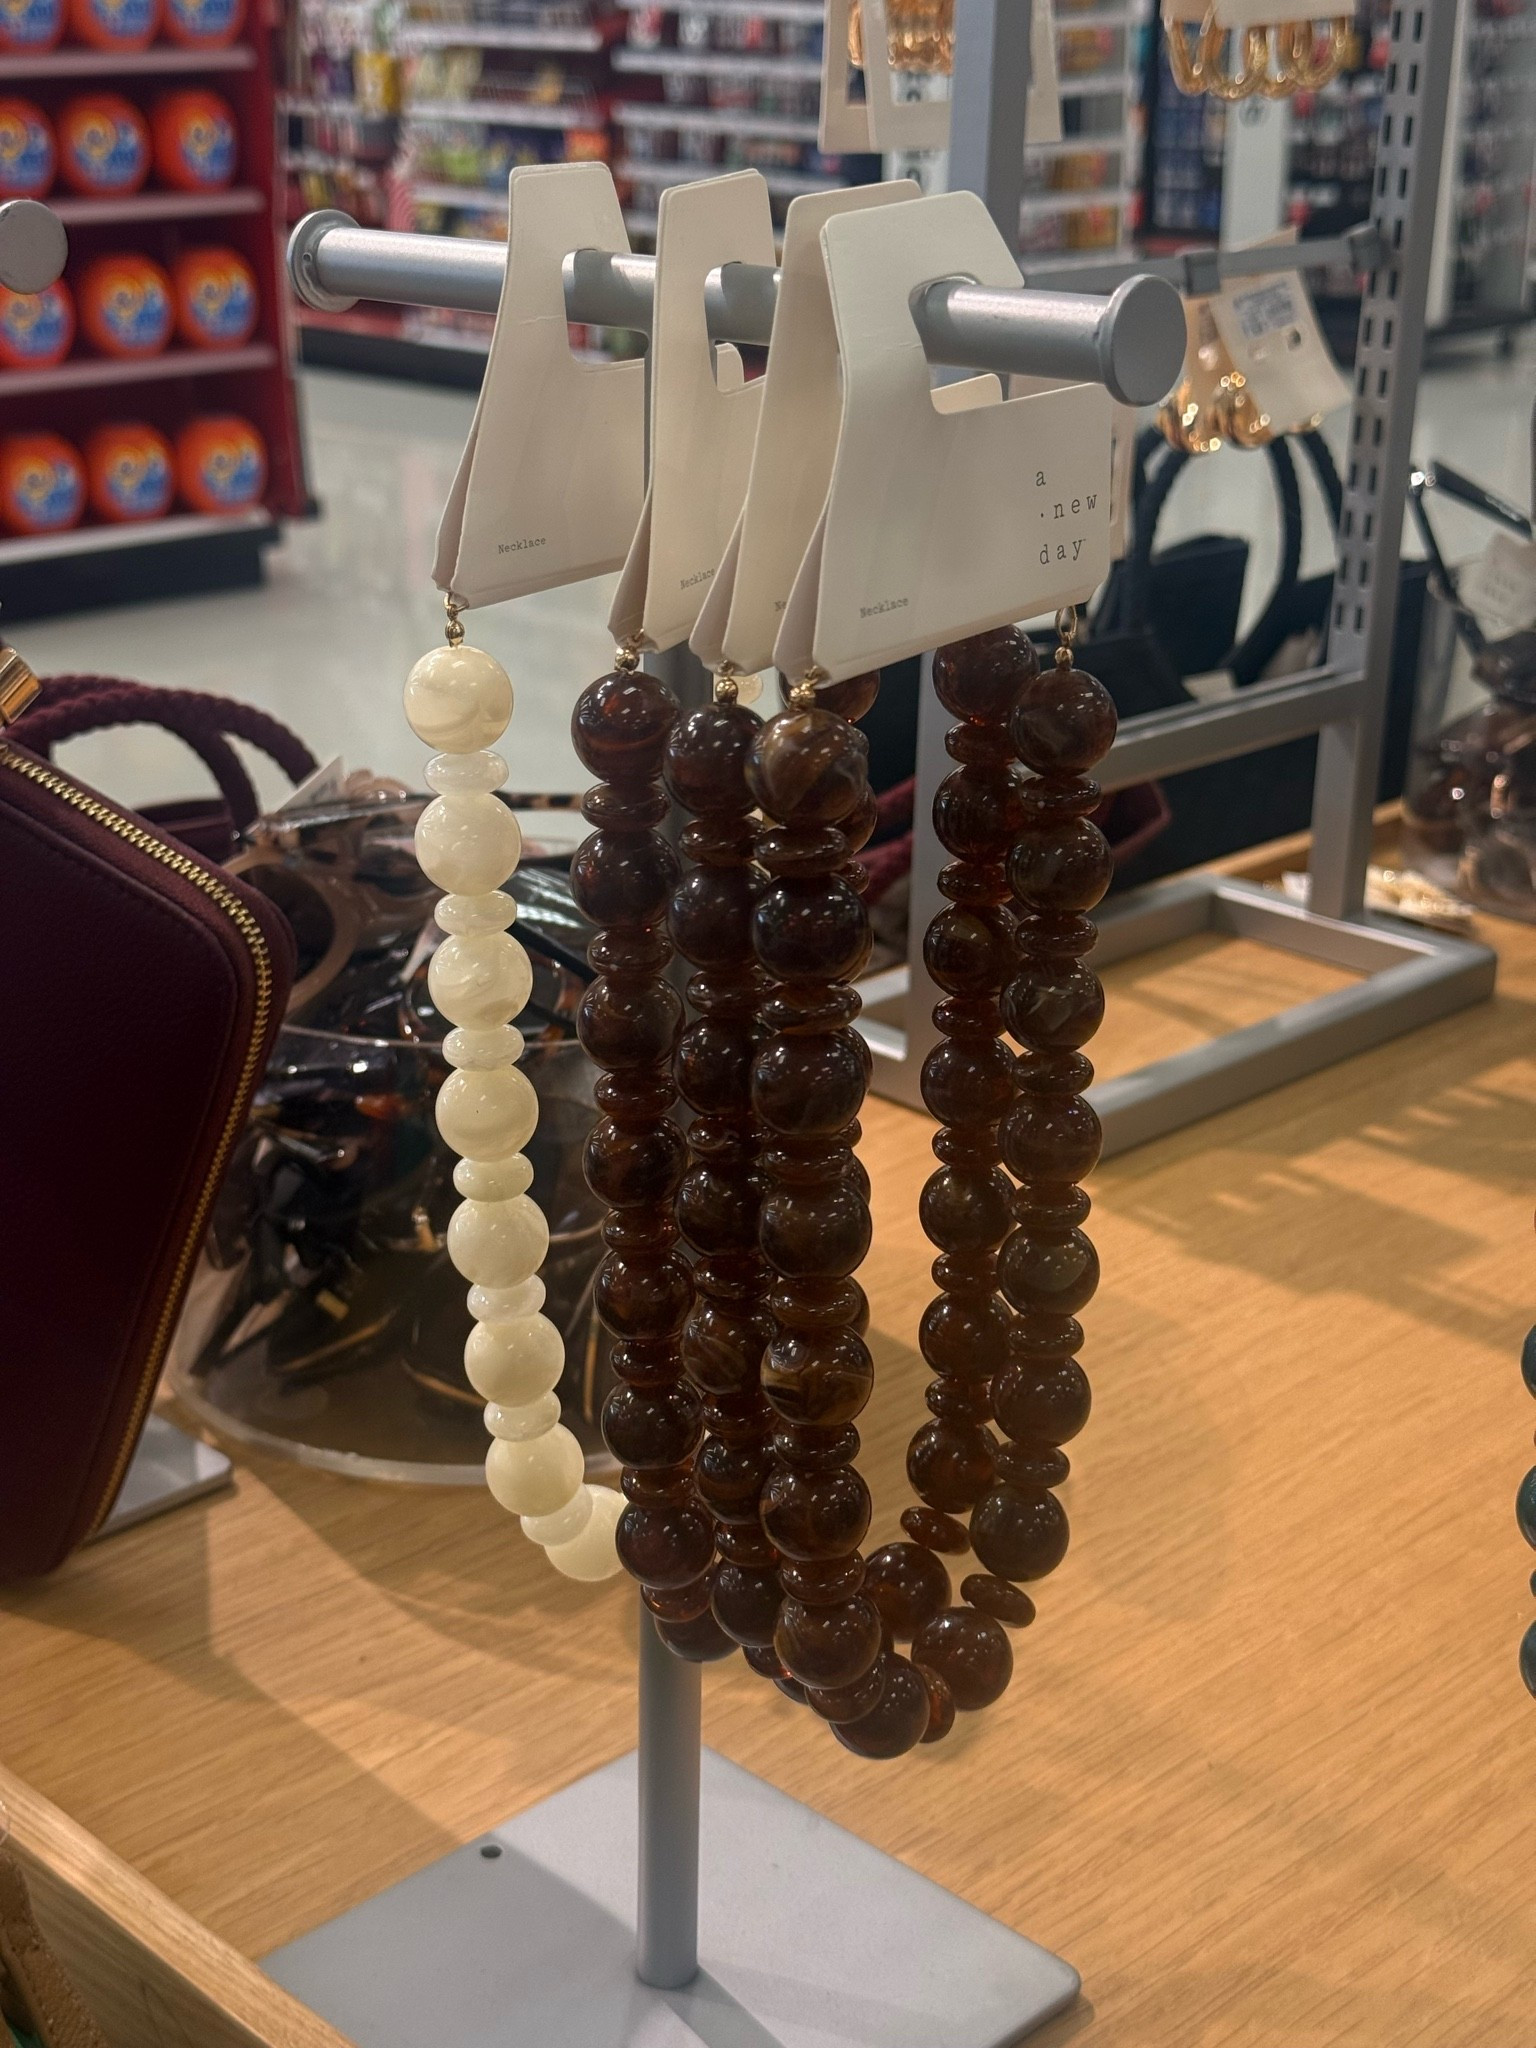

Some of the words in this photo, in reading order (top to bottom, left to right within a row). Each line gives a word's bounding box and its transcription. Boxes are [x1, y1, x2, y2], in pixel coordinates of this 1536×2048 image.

[1036, 471, 1046, 487] a
[498, 537, 546, 554] Necklace
[1039, 539, 1083, 565] day
[680, 568, 715, 590] Necklace
[859, 598, 909, 619] Necklace
